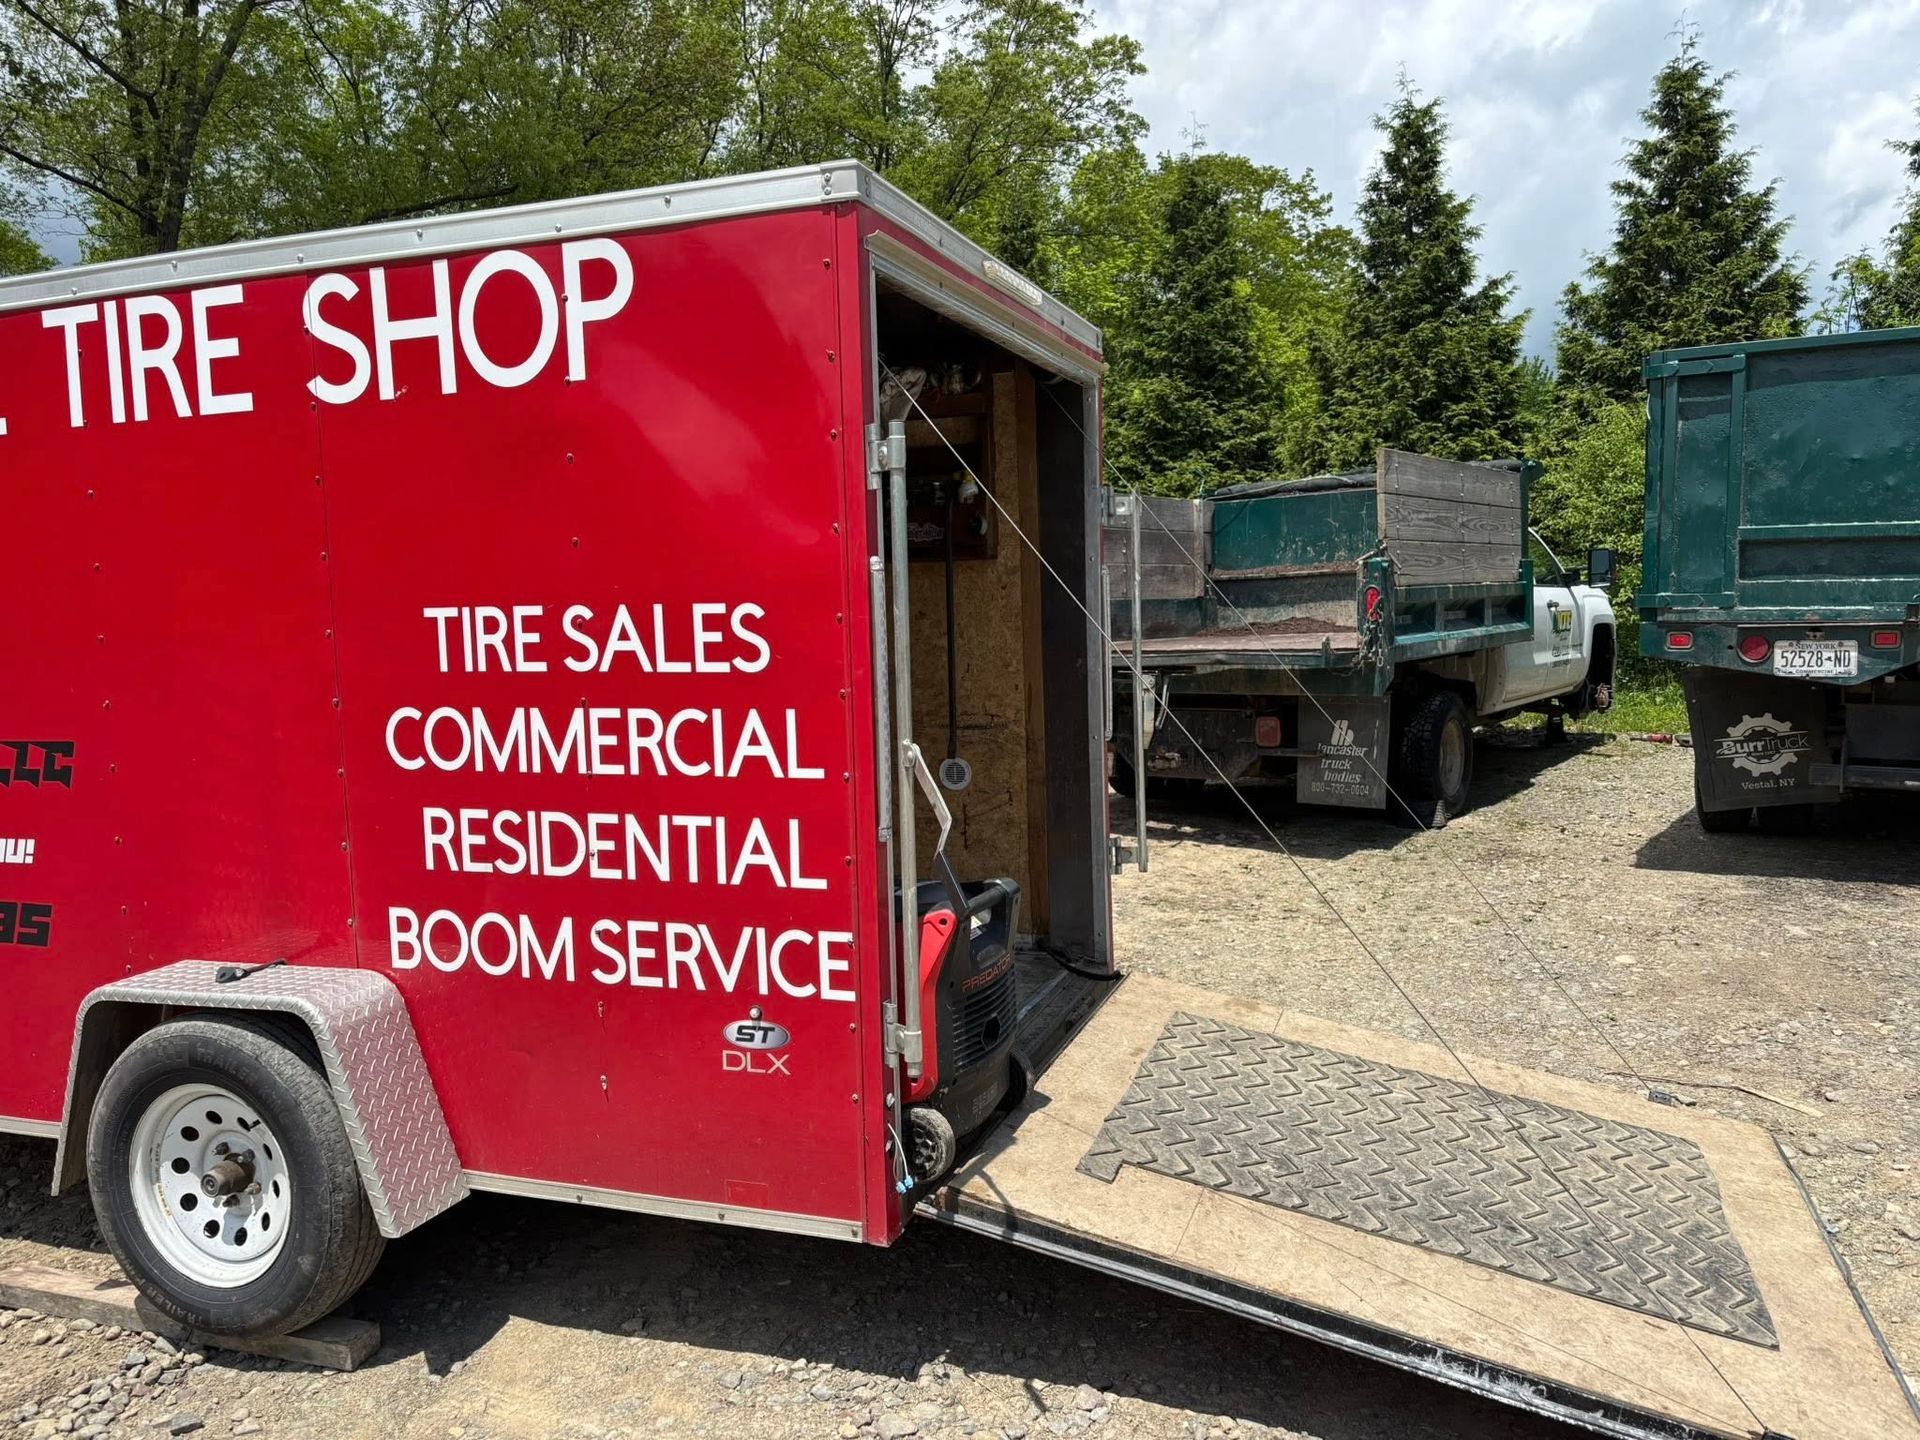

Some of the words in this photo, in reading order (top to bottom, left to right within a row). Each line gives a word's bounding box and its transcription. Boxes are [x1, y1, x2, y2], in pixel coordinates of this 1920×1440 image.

[42, 284, 254, 427] TIRE
[302, 238, 634, 405] SHOP
[423, 605, 548, 673] TIRE
[563, 602, 771, 673] SALES
[385, 706, 826, 780] COMMERCIAL
[0, 740, 75, 790] LC
[1320, 758, 1353, 770] truck
[1323, 770, 1362, 784] bodies
[1779, 777, 1796, 788] NY
[0, 838, 35, 864] U!
[422, 806, 828, 890] RESIDENTIAL
[388, 906, 576, 981] BOOM
[590, 918, 857, 1002] SERVICE
[960, 953, 1011, 993] PREDATOR
[735, 1025, 776, 1043] ST
[722, 1049, 791, 1076] DLX
